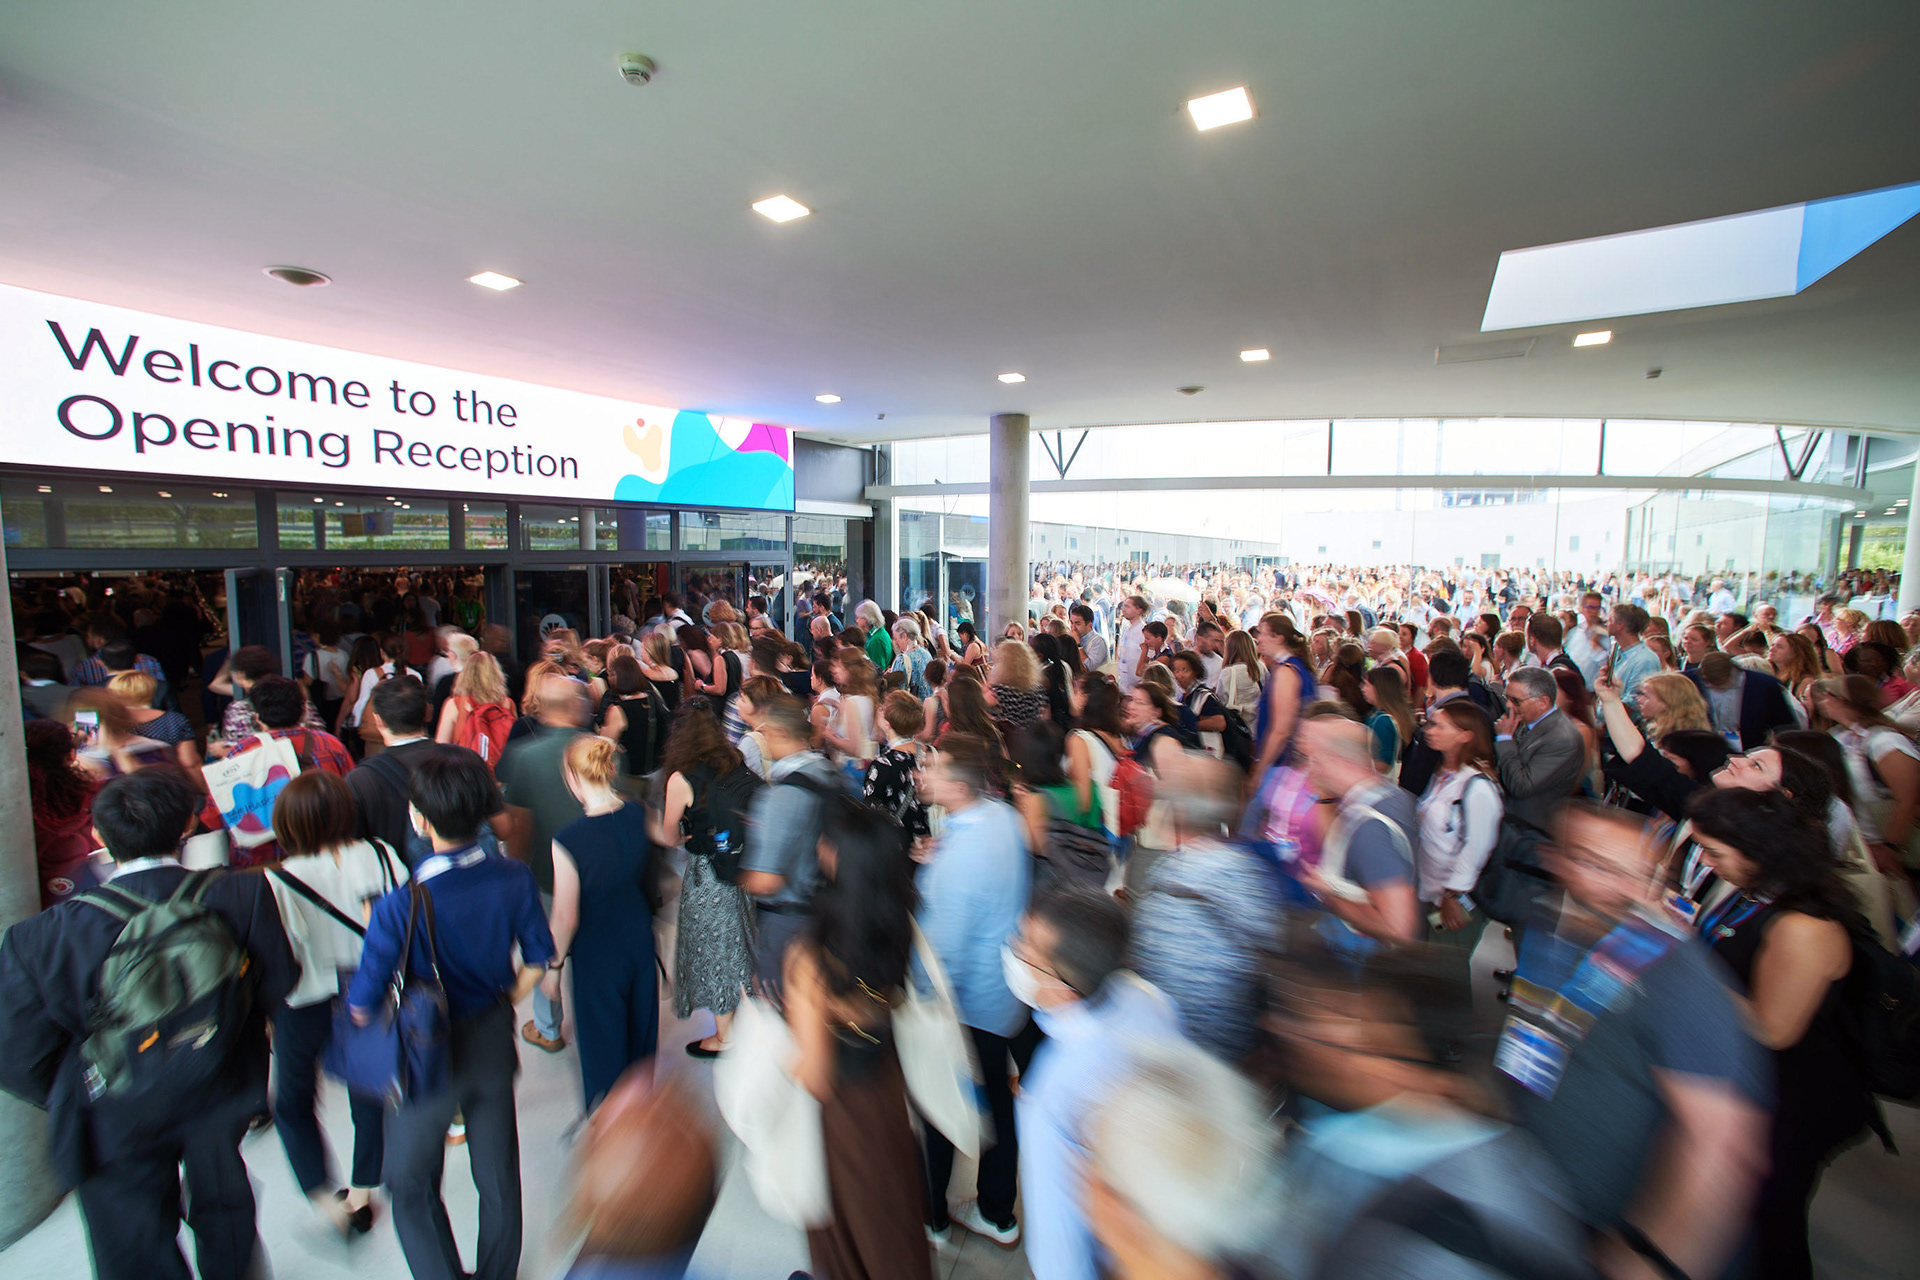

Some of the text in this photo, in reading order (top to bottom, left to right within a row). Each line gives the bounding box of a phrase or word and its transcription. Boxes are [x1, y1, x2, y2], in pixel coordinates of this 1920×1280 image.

[46, 319, 518, 428] Welcome to the
[57, 394, 579, 481] Opening Reception
